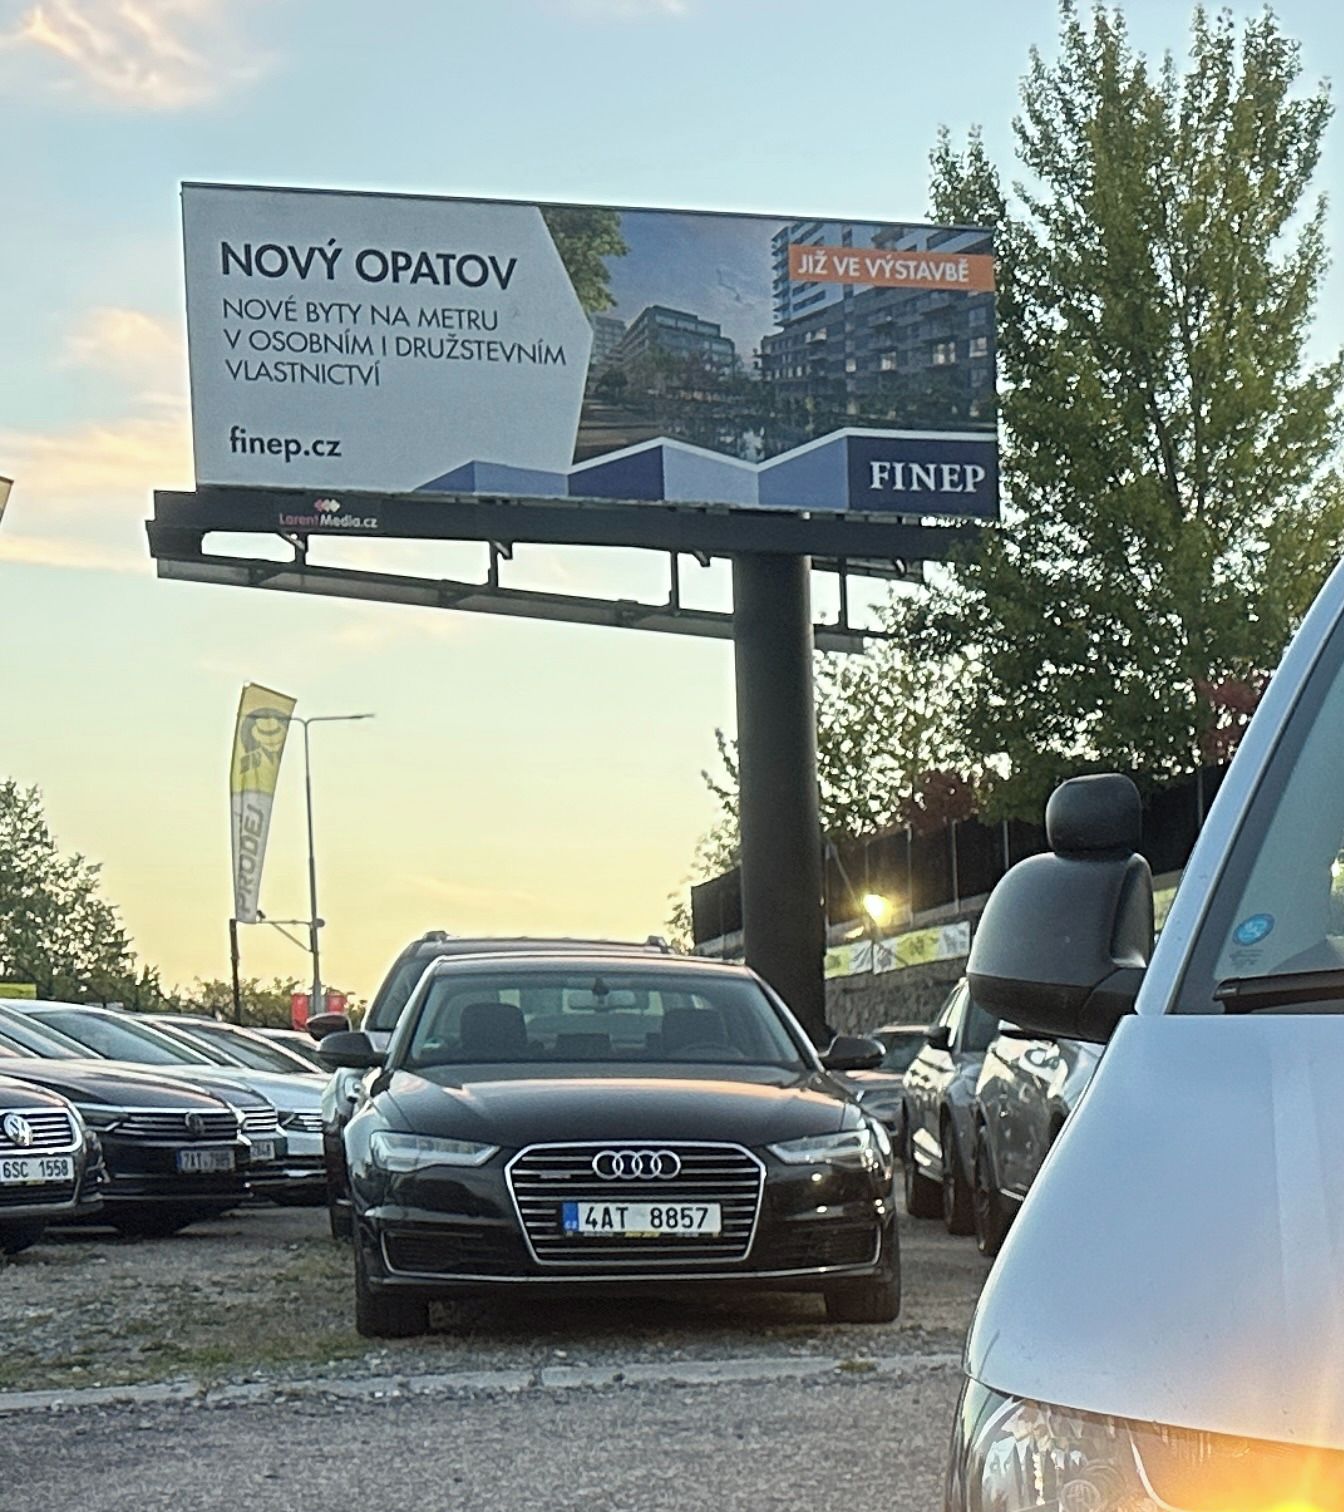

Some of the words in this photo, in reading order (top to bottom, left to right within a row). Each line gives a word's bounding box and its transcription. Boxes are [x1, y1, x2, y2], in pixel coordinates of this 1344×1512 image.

[221, 238, 343, 280] NOVÝ
[355, 248, 518, 290] OPATOV
[798, 250, 828, 275] JIŽ
[833, 255, 861, 276] VE
[865, 254, 970, 283] VÝSTAVBĚ
[223, 295, 298, 322] NOVÉ
[306, 302, 362, 325] BYTY
[370, 305, 411, 328] NA
[417, 308, 499, 332] METRU
[223, 329, 242, 349] V
[249, 328, 374, 356] OSOBNÍM
[382, 336, 387, 357] I
[395, 333, 567, 366] DRUŽSTEVNÍM
[225, 359, 381, 387] VLASTNICTVÍ
[229, 425, 343, 463] finep.cz
[869, 461, 986, 493] FINEP
[237, 803, 264, 913] PRODEJ
[2, 1160, 29, 1179] 6SC
[39, 1159, 69, 1177] 1558
[585, 1206, 629, 1230] 4AT
[650, 1207, 709, 1229] 8857
